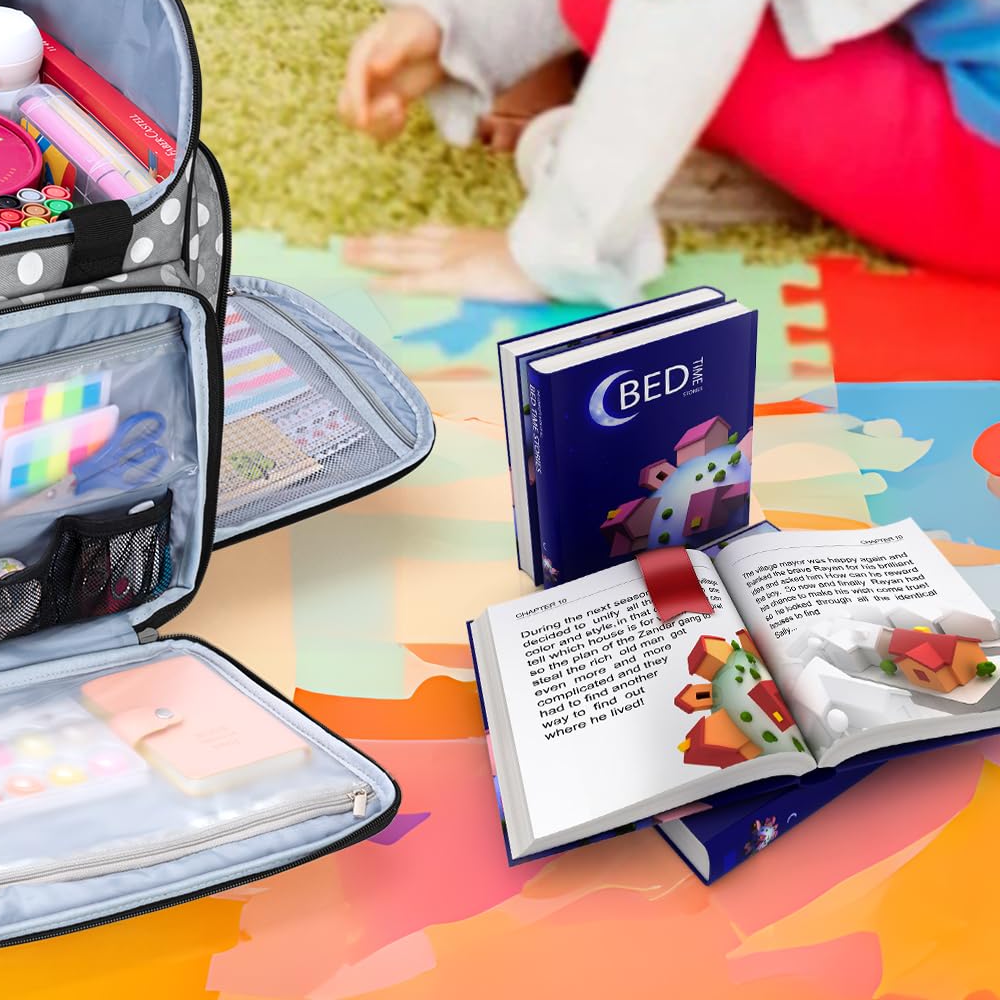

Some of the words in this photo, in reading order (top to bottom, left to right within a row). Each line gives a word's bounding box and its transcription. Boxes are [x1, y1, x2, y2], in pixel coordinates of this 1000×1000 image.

[529, 383, 537, 407] BED
[620, 364, 690, 411] BED
[692, 356, 704, 387] TIME
[531, 407, 540, 433] TIME
[533, 433, 542, 474] STORIES
[860, 536, 895, 545] CHAPTER
[742, 570, 755, 580] The
[754, 563, 778, 574] village
[779, 560, 806, 568] mayor
[827, 556, 858, 564] happy
[860, 555, 887, 563] again
[888, 551, 908, 560] and
[765, 580, 780, 590] and
[805, 573, 824, 581] him
[883, 566, 919, 577] reward
[772, 569, 786, 577] the
[786, 567, 812, 575] brave
[812, 565, 845, 573] Rayan
[876, 559, 915, 570] brilliant
[755, 595, 767, 605] the
[765, 590, 782, 599] boy.
[784, 585, 797, 593] So
[818, 580, 837, 589] and
[837, 579, 866, 587] finally
[870, 578, 904, 586] Rayan
[904, 573, 926, 583] had
[759, 604, 771, 613] his
[770, 595, 798, 608] chance
[807, 589, 834, 598] make
[905, 581, 930, 591] true!
[765, 613, 774, 622] so
[774, 607, 786, 616] he
[785, 600, 813, 612] looked
[815, 596, 853, 606] through
[894, 588, 938, 601] identical
[515, 601, 556, 619] CHAPTER
[520, 621, 561, 639] During
[564, 614, 583, 624] the
[586, 603, 612, 617] next
[523, 627, 572, 648] decided
[574, 622, 587, 631] to
[592, 610, 620, 624] unify
[626, 603, 639, 612] all
[769, 615, 794, 630] houses
[803, 608, 821, 617] find
[525, 643, 556, 658] color
[559, 633, 583, 646] and
[629, 608, 652, 621] that
[527, 655, 546, 667] tell
[548, 643, 585, 660] which
[588, 629, 625, 646] house
[627, 623, 638, 632] is
[639, 616, 654, 628] for
[529, 667, 545, 677] so
[548, 659, 569, 671] the
[572, 648, 599, 664] plan
[601, 640, 614, 652] of
[616, 635, 635, 647] the
[637, 621, 676, 639] Zandar
[677, 614, 702, 627] gang
[532, 670, 563, 687] steal
[566, 664, 586, 676] the
[589, 654, 613, 667] rich
[619, 643, 638, 656] old
[640, 635, 665, 649] man
[670, 628, 688, 640] got
[534, 681, 567, 697] even
[574, 667, 607, 684] more
[613, 655, 637, 670] and
[642, 643, 672, 659] more
[536, 674, 615, 708] complicated
[617, 664, 641, 679] and
[643, 655, 668, 669] they
[539, 703, 566, 718] had
[568, 699, 582, 709] to
[584, 688, 609, 703] find
[611, 670, 659, 693] another
[541, 714, 570, 730] way
[572, 708, 586, 719] to
[593, 696, 618, 711] find
[624, 686, 646, 699] out
[544, 721, 587, 741] where
[589, 713, 607, 725] he
[610, 697, 646, 718] lived!
